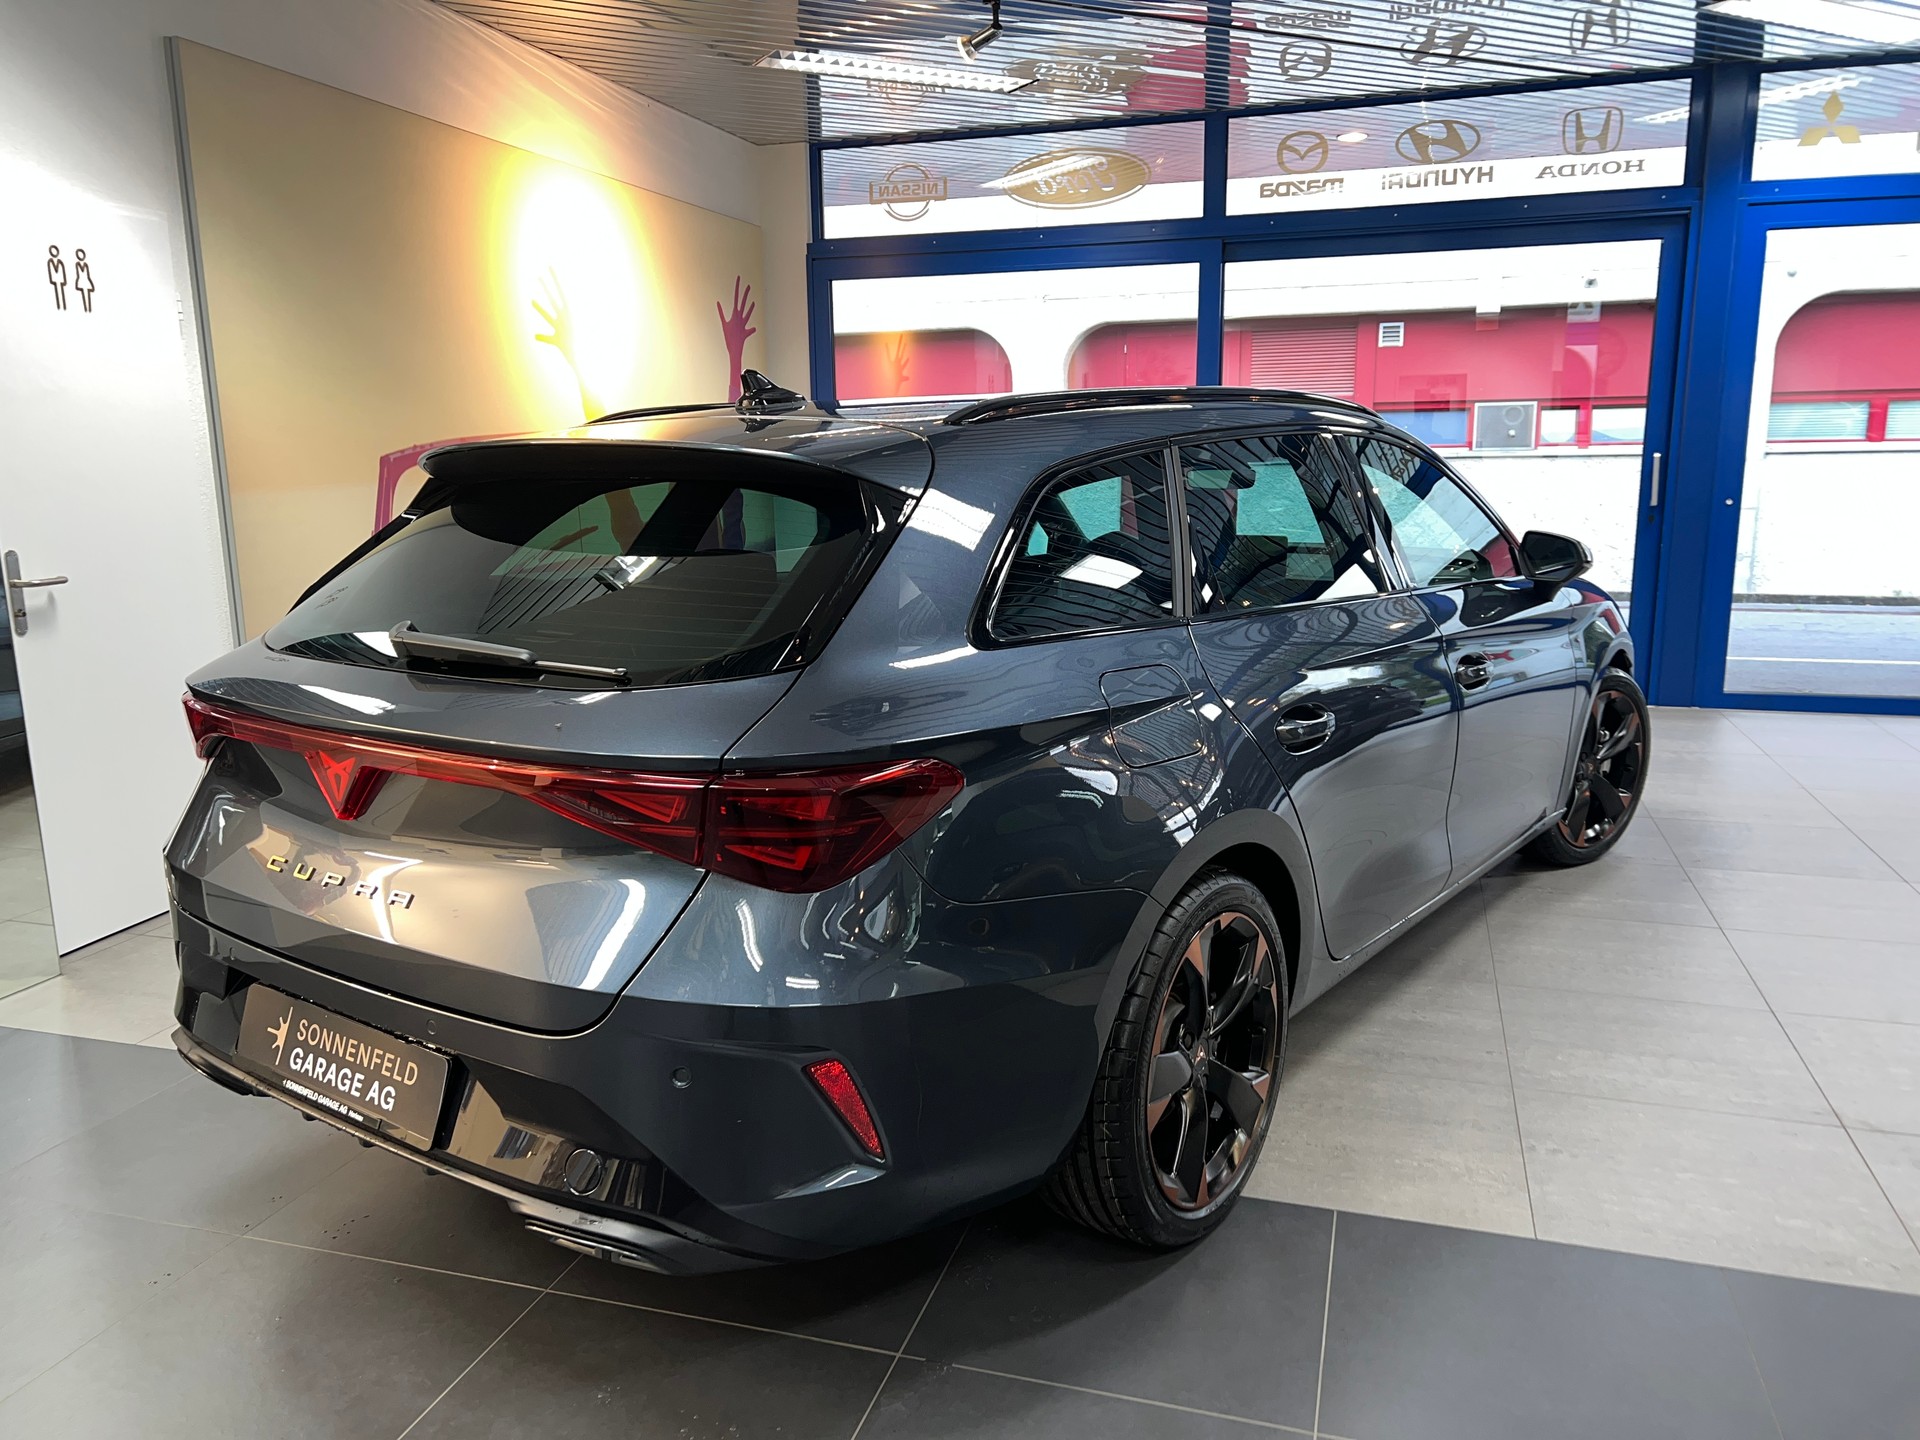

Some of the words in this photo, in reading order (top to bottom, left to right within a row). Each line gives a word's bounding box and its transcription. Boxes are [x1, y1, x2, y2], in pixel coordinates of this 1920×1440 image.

[266, 855, 415, 909] CUPRA
[289, 1047, 365, 1098] GARAGE
[365, 1080, 396, 1111] AG
[297, 1018, 418, 1086] SONNENFELD
